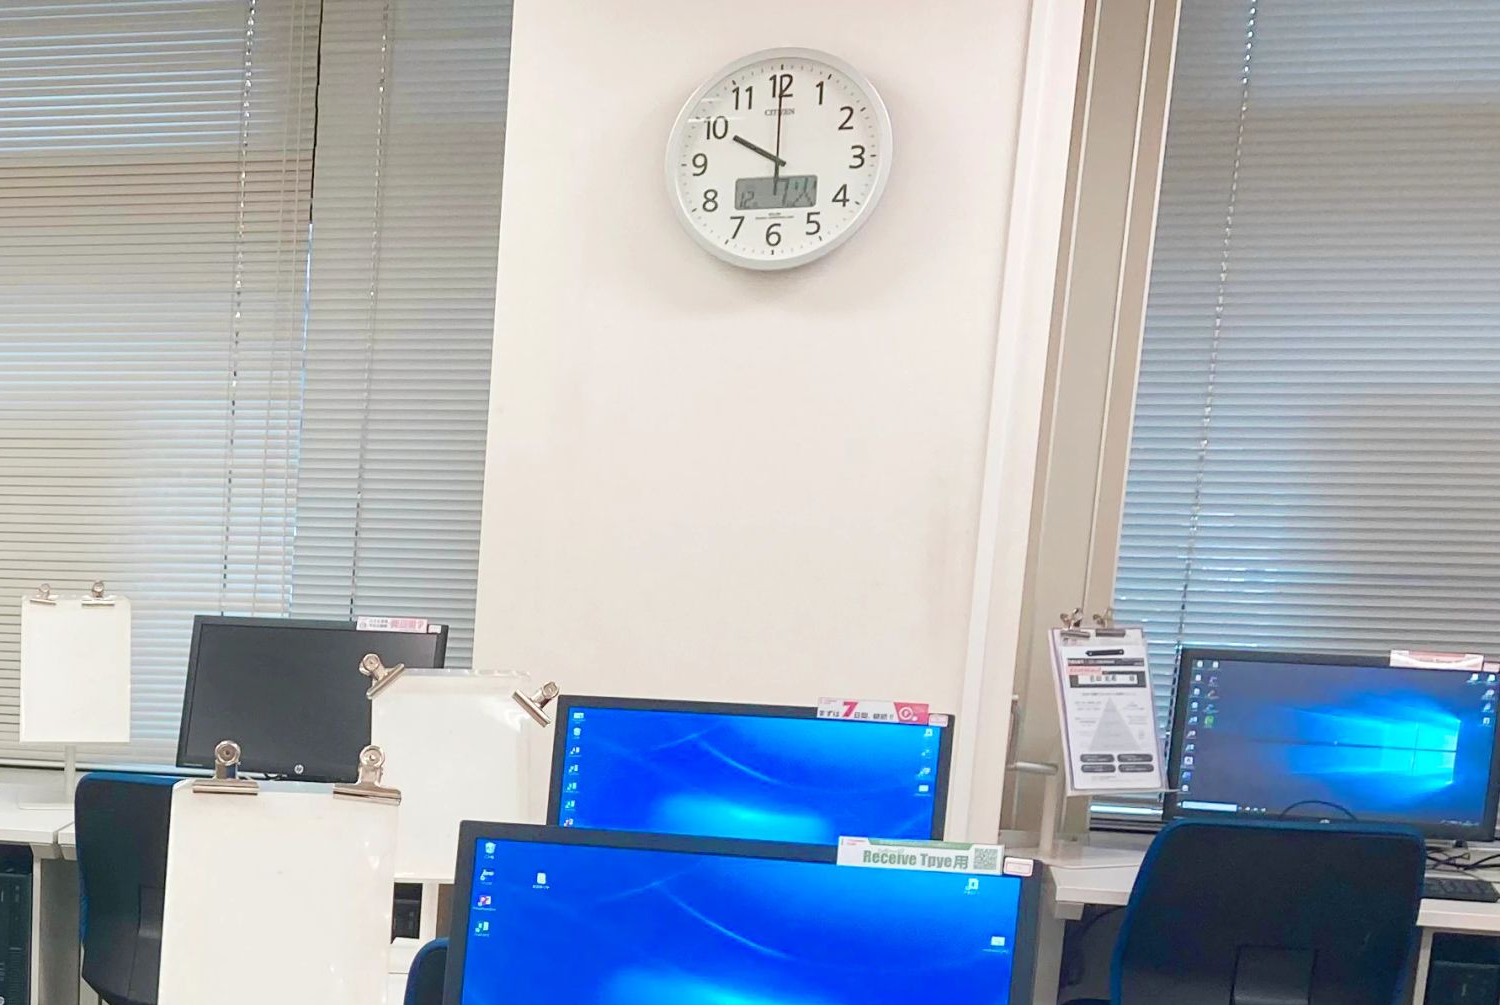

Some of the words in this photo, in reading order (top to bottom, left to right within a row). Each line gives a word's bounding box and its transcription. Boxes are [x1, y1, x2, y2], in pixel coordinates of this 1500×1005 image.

[732, 85, 753, 110] 11
[769, 74, 793, 98] 12
[815, 81, 824, 105] 1
[764, 108, 795, 116] CITZEN
[838, 106, 854, 130] 2
[705, 116, 728, 140] 10
[692, 153, 708, 176] 9
[849, 145, 866, 169] 3
[702, 189, 718, 212] 8
[831, 184, 850, 207] 4
[730, 216, 745, 239] 7
[765, 223, 781, 247] 6
[805, 212, 821, 235] 5
[862, 850, 917, 866] Receive
[920, 853, 969, 869] Tpye用
